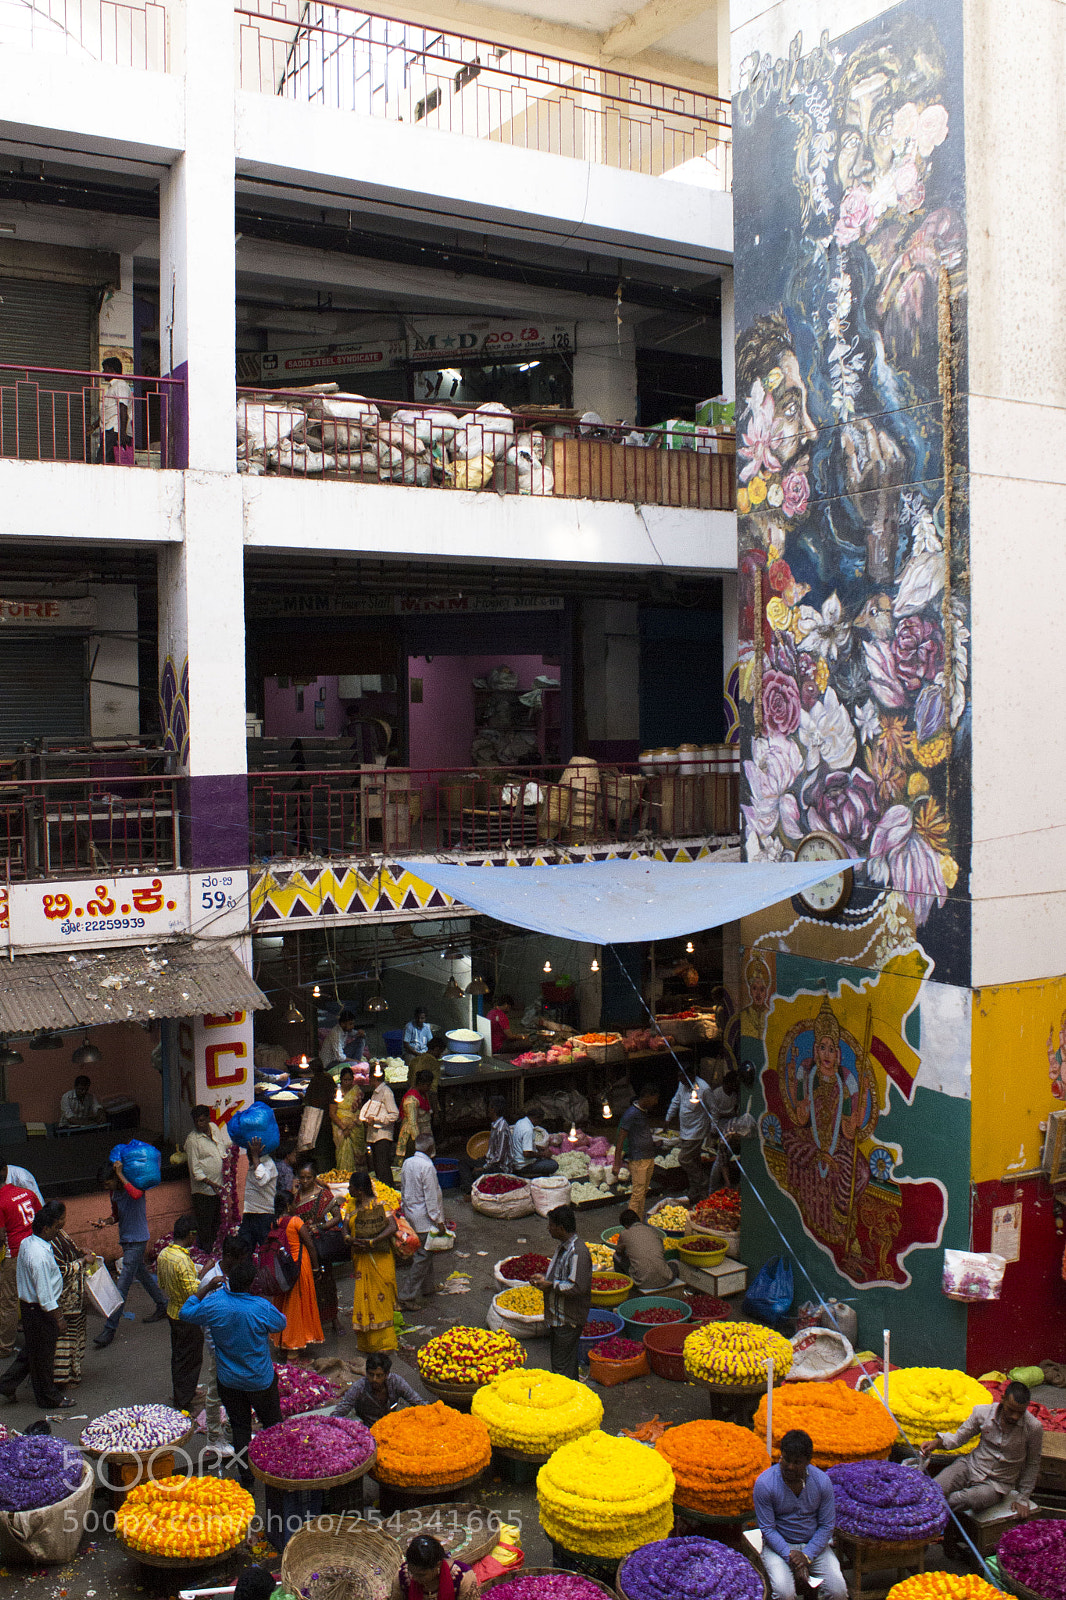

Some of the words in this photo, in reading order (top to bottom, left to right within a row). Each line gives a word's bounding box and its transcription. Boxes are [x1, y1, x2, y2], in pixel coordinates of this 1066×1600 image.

[552, 333, 570, 349] 126
[288, 359, 311, 369] SADIQ
[312, 357, 335, 367] STEEL
[337, 353, 380, 364] SYNDICATE
[283, 595, 329, 611] MNM
[400, 597, 469, 611] MNM
[17, 1199, 36, 1226] 15
